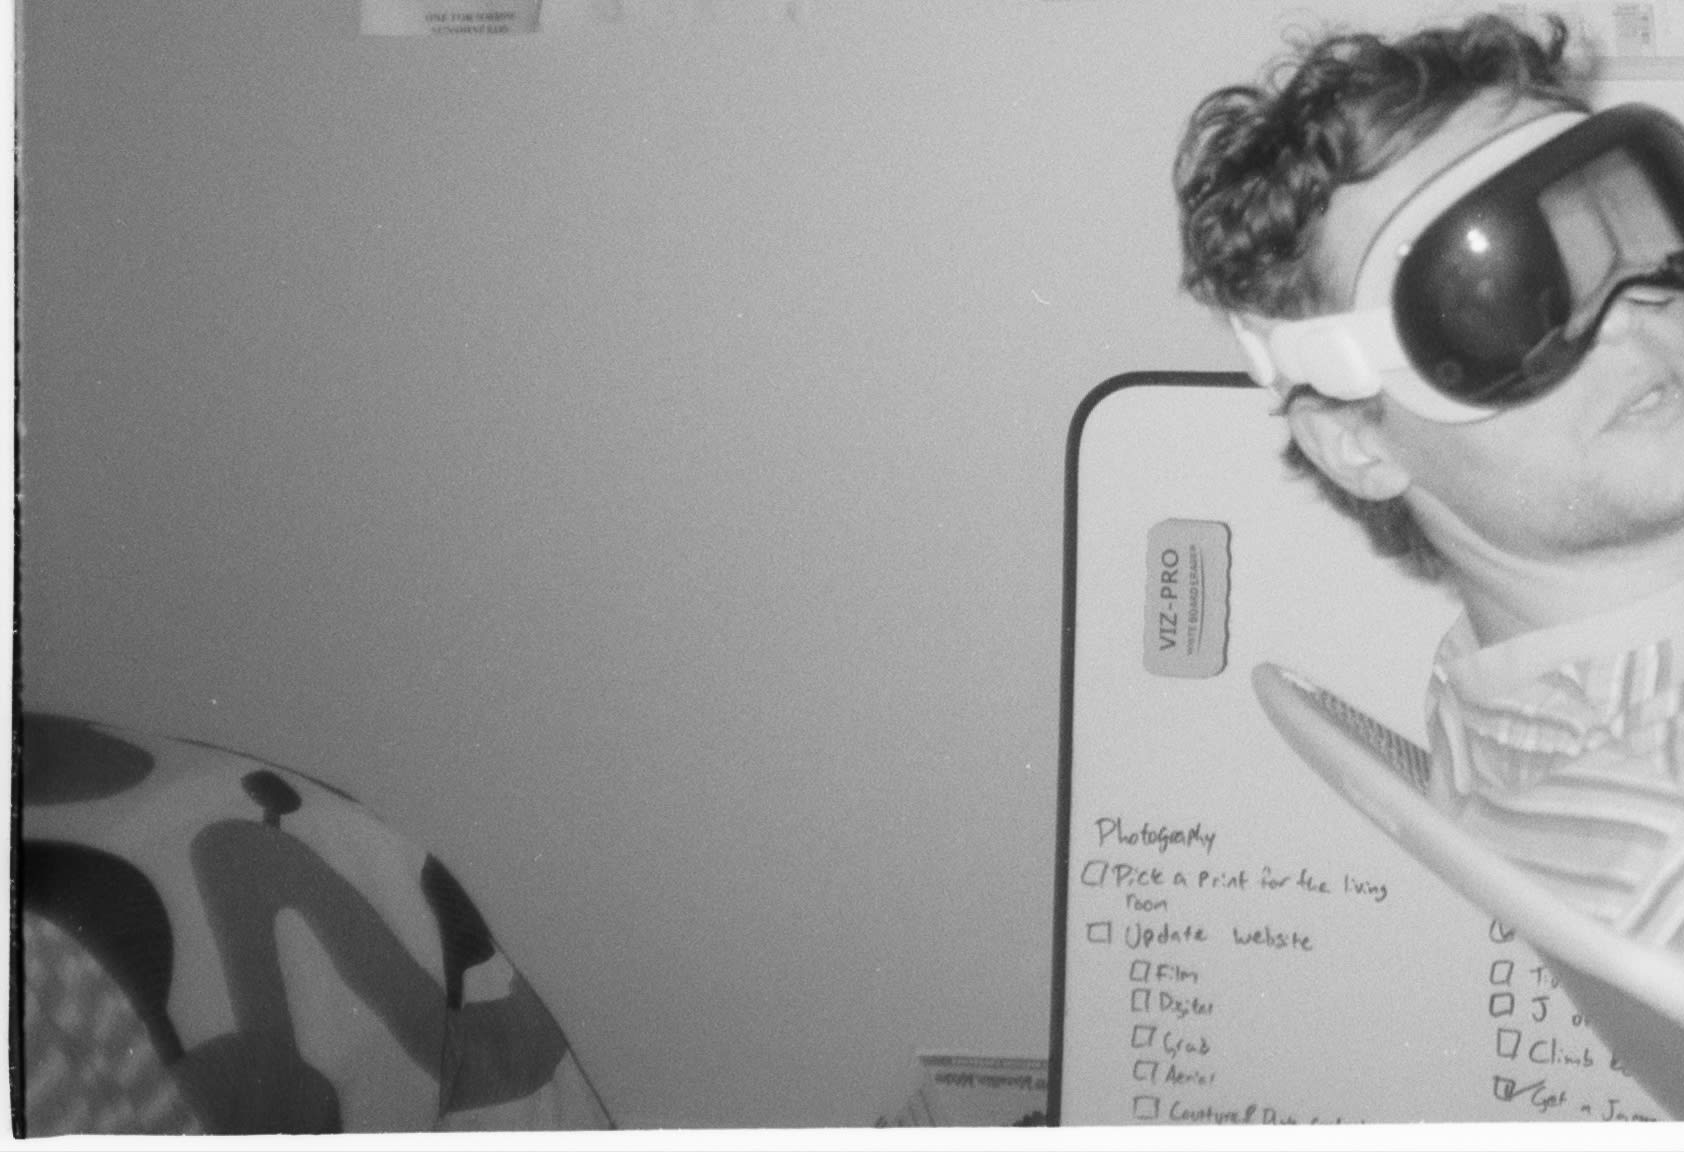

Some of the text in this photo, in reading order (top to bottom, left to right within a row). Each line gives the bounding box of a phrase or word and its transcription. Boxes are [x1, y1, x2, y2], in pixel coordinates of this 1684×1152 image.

[1158, 547, 1181, 652] VIZ-PRO
[1095, 816, 1217, 855] Photography
[1112, 863, 1164, 888] Pick
[1172, 871, 1188, 888] a
[1260, 865, 1291, 890] for
[1296, 867, 1332, 894] the
[1343, 873, 1389, 904] living
[1124, 922, 1208, 950] Update
[1156, 963, 1199, 984] Film
[1528, 1036, 1595, 1069] Climb
